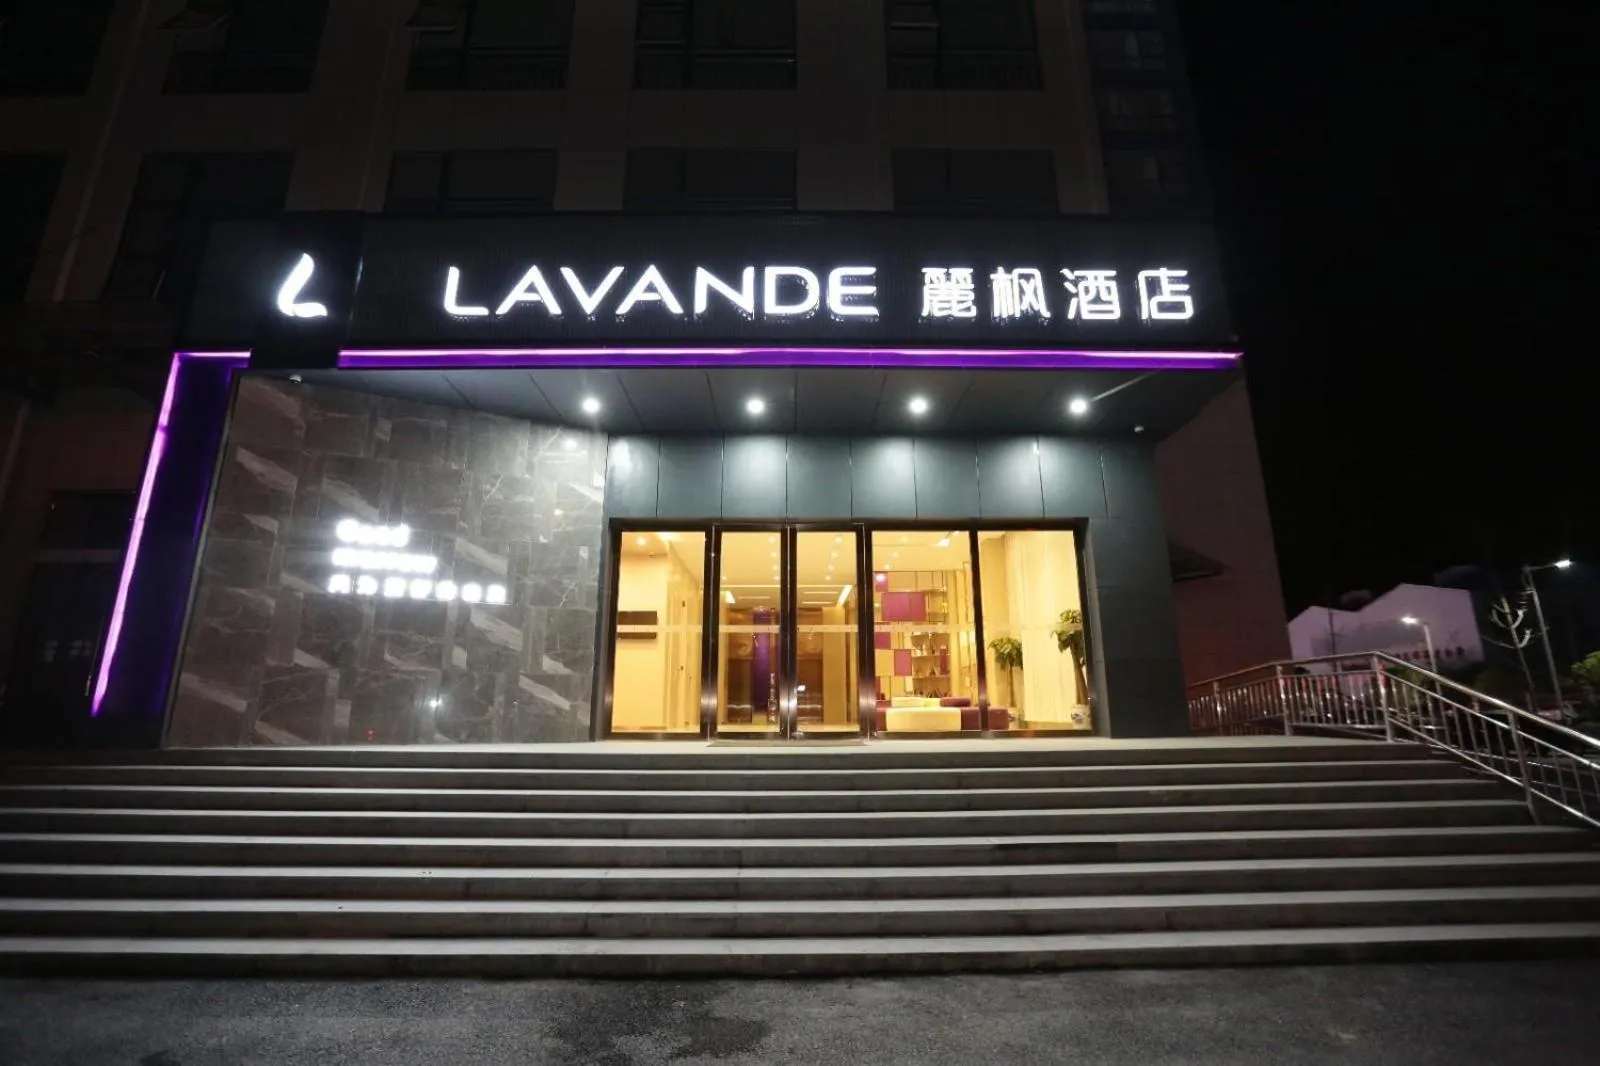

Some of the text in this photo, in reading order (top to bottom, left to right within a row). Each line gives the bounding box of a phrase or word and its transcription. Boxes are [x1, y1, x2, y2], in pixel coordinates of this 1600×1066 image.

[443, 264, 880, 317] LAVANDE
[920, 266, 1194, 320] 麗枫酒店
